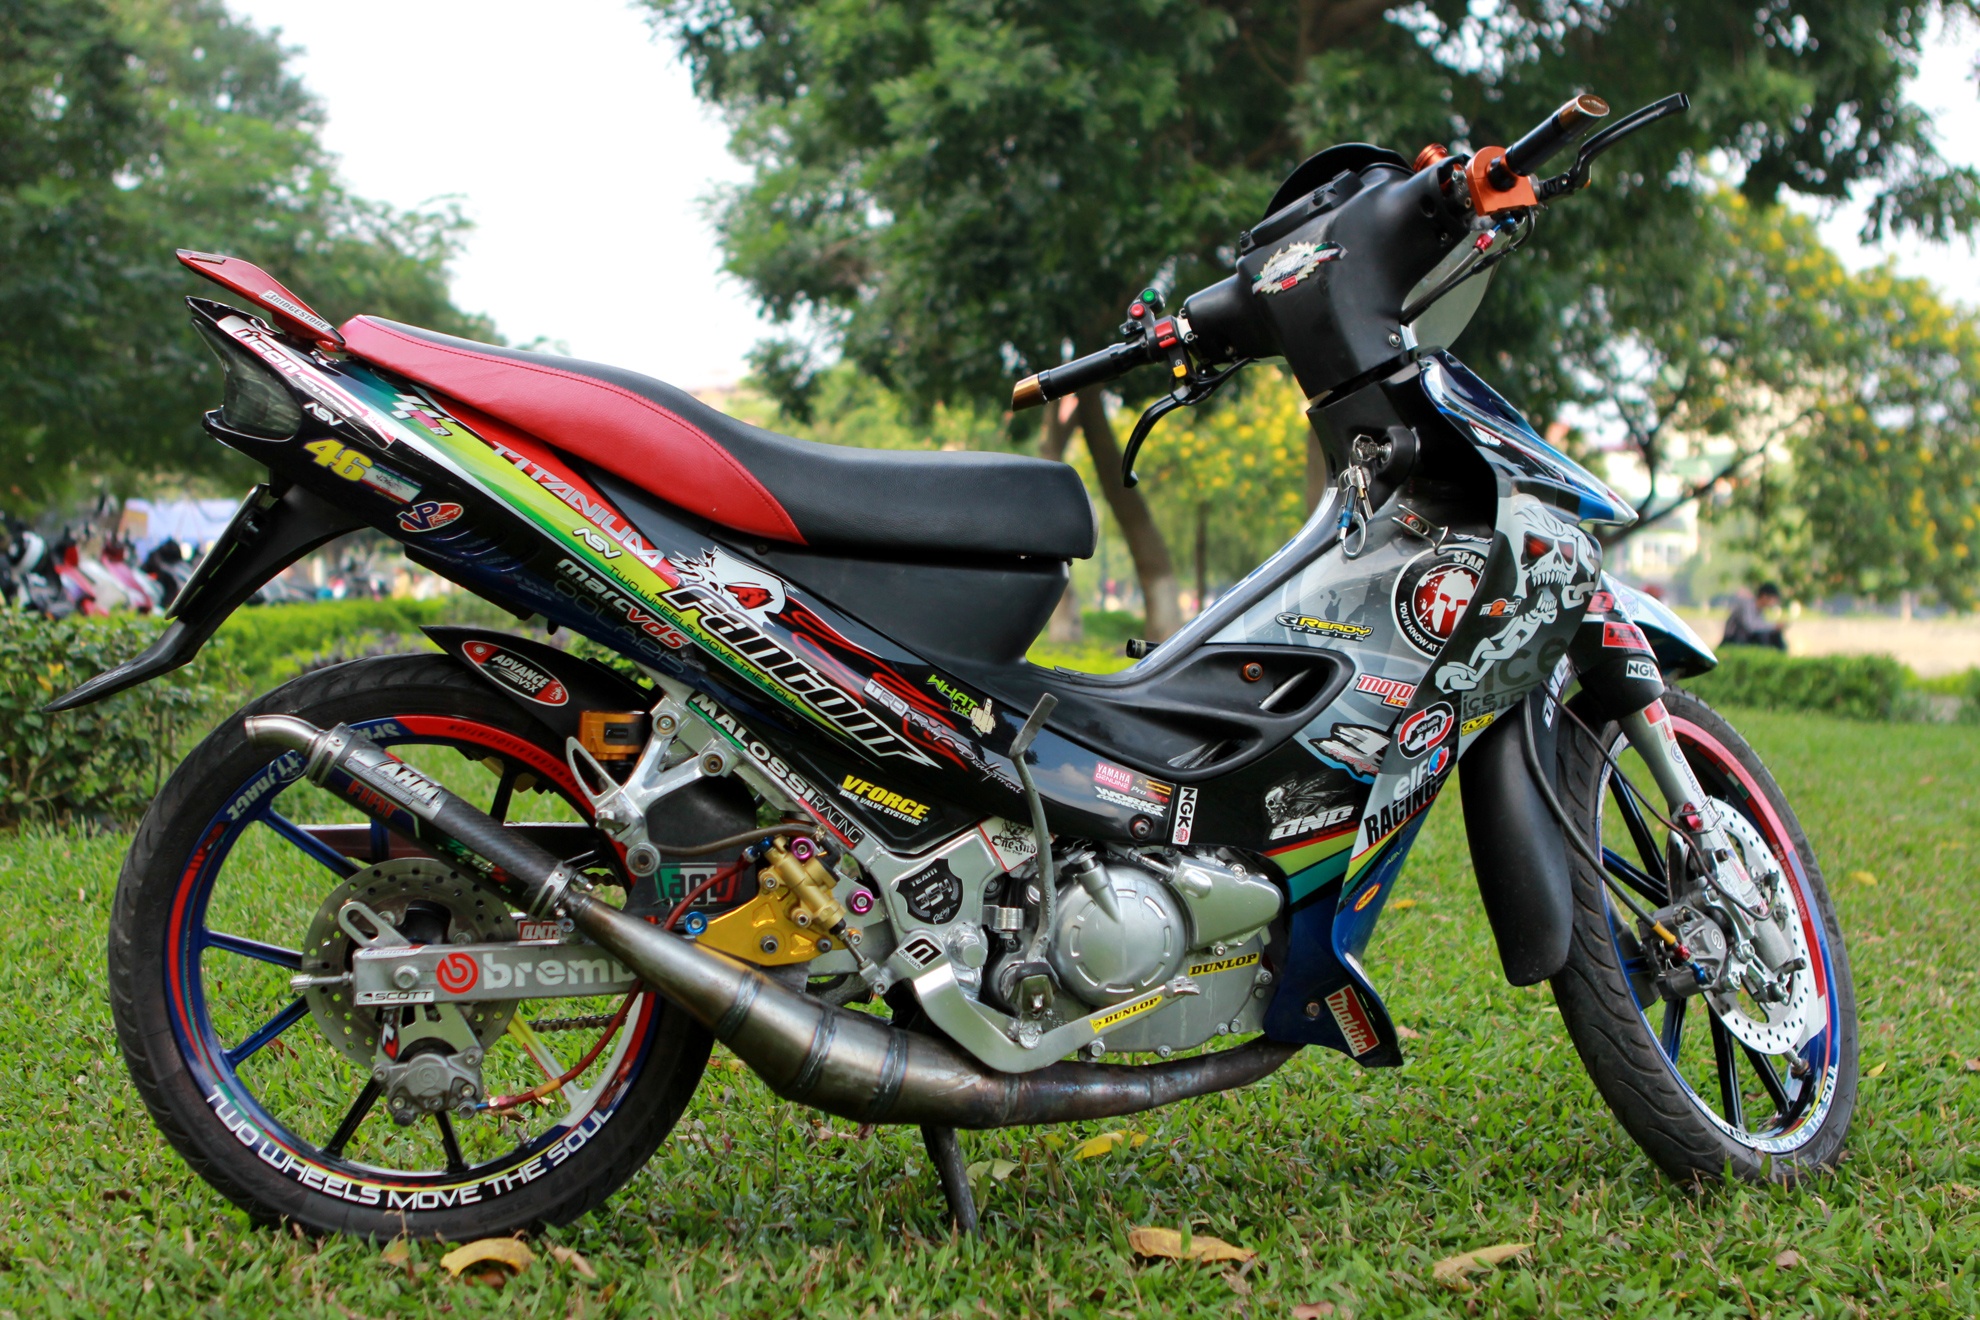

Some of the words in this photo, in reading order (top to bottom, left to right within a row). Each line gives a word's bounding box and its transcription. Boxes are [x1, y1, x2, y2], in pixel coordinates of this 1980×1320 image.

[265, 290, 329, 331] BRIDGESTONE
[303, 438, 374, 482] 46
[396, 501, 441, 531] VP
[492, 441, 668, 569] TITANIUM
[572, 527, 623, 559] ASV
[610, 564, 639, 591] TWO
[639, 587, 697, 634] WHEELS
[697, 633, 738, 665] MOVE
[739, 660, 768, 686] THE
[767, 682, 802, 708] SOUL
[1407, 623, 1429, 647] KNOW
[1426, 643, 1438, 652] AT
[492, 653, 550, 690] ADVANCE
[518, 676, 540, 694] VSX
[1627, 661, 1657, 679] NGK
[927, 674, 979, 710] WHAT
[377, 762, 440, 803] AHM
[694, 692, 817, 801] MALOSSI
[809, 797, 864, 843] RACING
[1095, 773, 1129, 790] GENUINE
[1097, 764, 1131, 784] YAMAHA
[1393, 758, 1429, 800] elf
[347, 780, 400, 818] FIAT
[839, 789, 860, 801] REED
[860, 797, 885, 812] VALVE
[884, 807, 922, 826] SYSTEMS
[842, 775, 931, 820] VFORCE
[1094, 786, 1167, 812] WORKS
[1096, 794, 1164, 818] CONNECTION
[1177, 788, 1196, 828] NGK
[910, 868, 938, 888] TEAM
[1191, 954, 1258, 975] DUNLOP
[375, 990, 432, 1002] SCOTT
[1105, 998, 1160, 1024] DUNLOP
[1778, 1129, 1810, 1151] MOVE
[1808, 1105, 1827, 1132] THE
[1821, 1064, 1839, 1106] SOUL
[207, 1083, 259, 1147] TWO
[257, 1141, 381, 1206] WHEELS
[387, 1183, 482, 1211] MOVE
[485, 1162, 548, 1196] THE
[546, 1108, 614, 1169] SOUL
